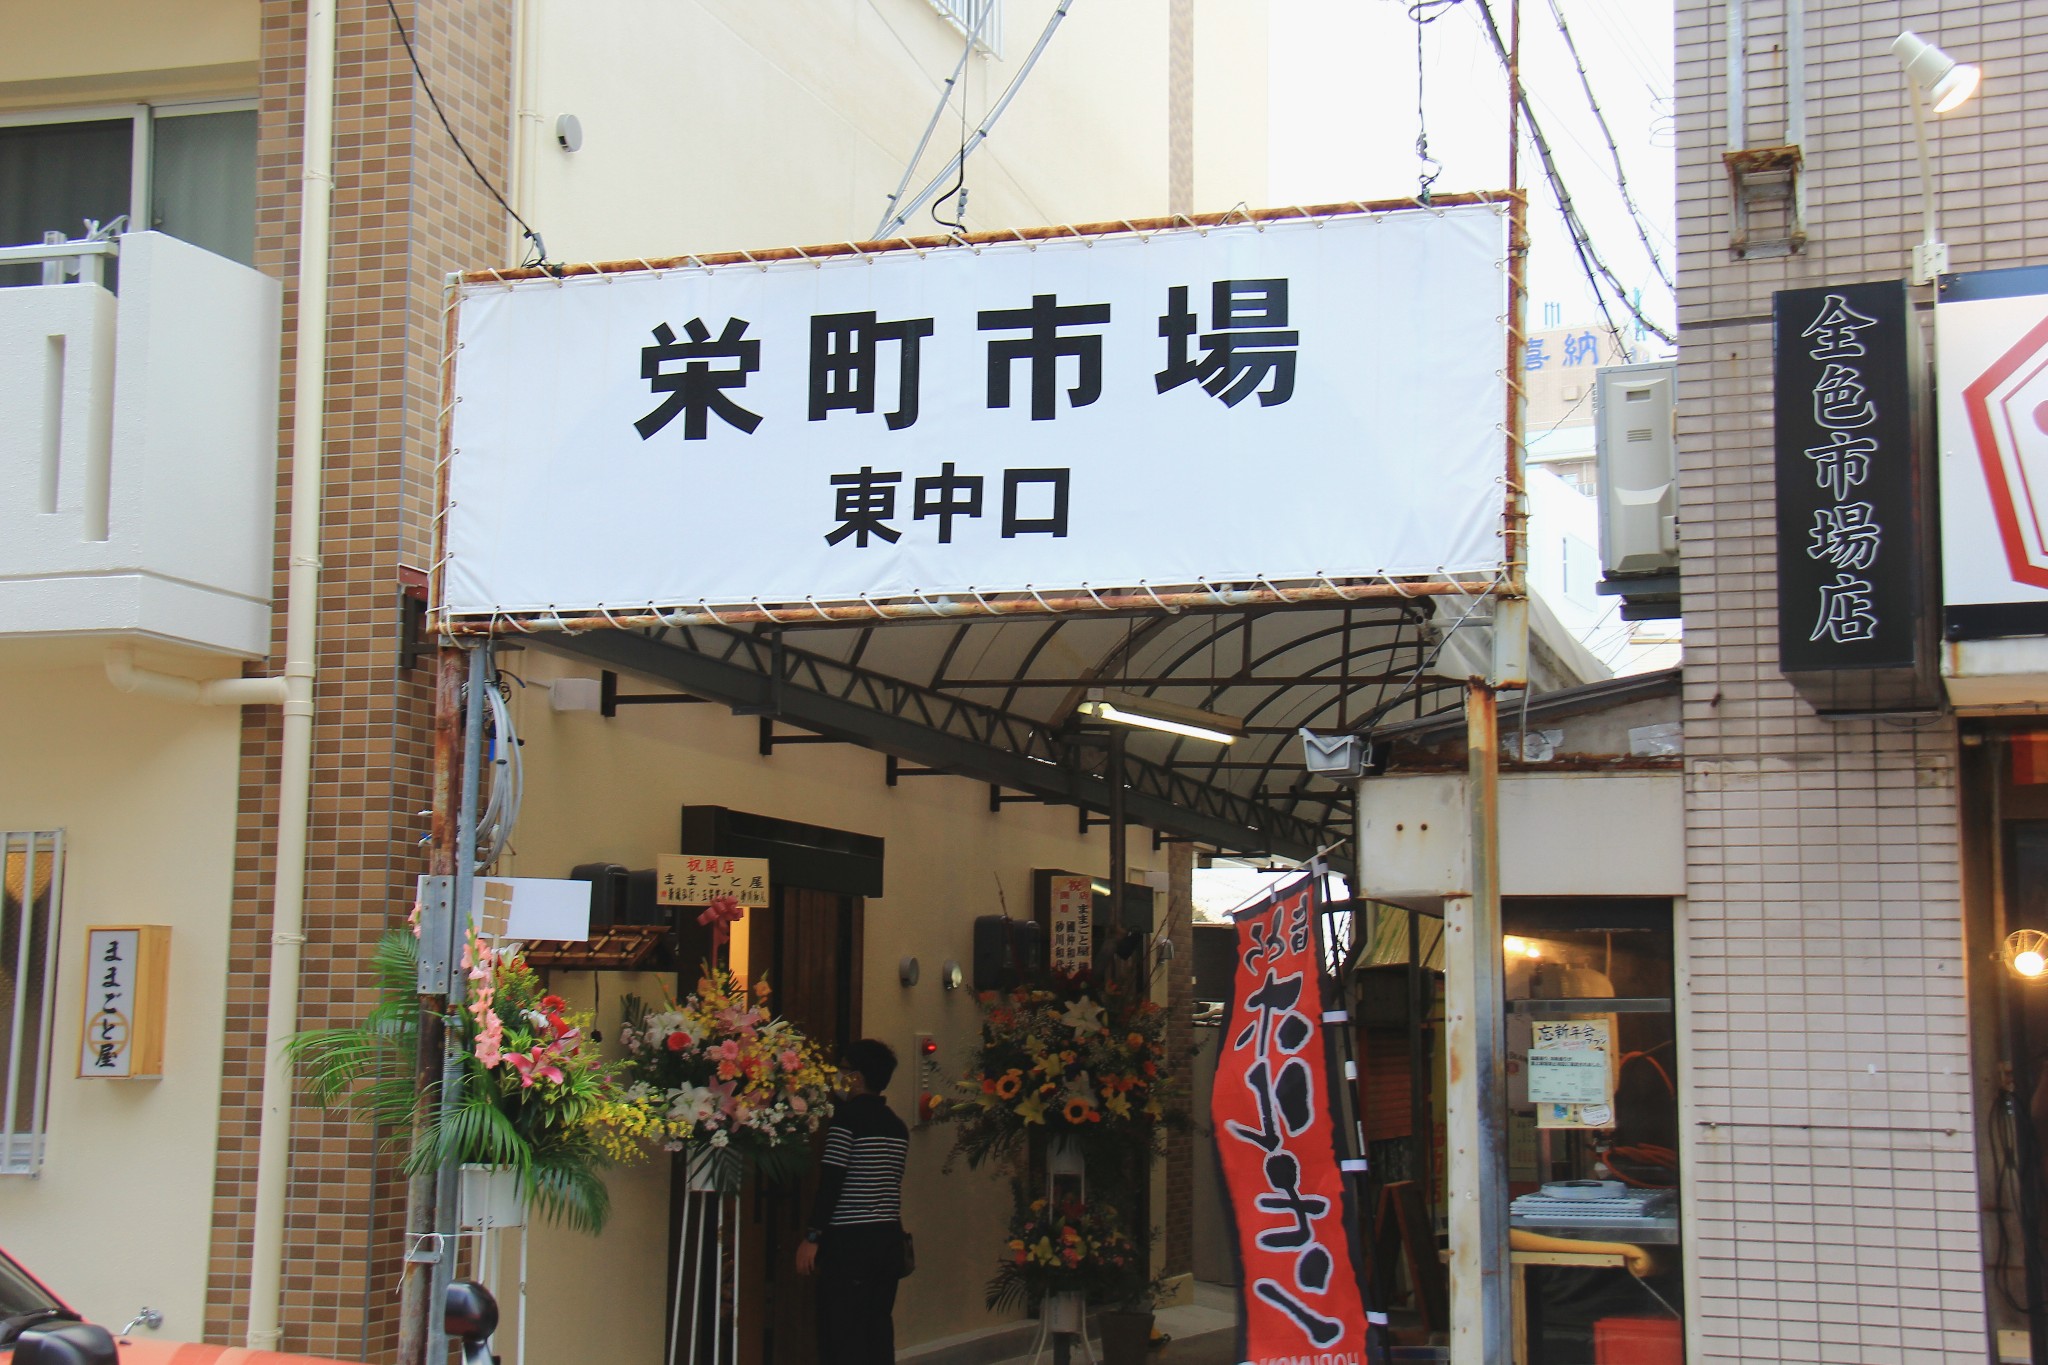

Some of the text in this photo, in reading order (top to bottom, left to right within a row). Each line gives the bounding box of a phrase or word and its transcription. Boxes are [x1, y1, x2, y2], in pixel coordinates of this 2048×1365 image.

[633, 278, 1300, 441] 栄町市場
[823, 462, 1071, 548] 東中口
[1801, 294, 1882, 644] 全色市場店
[664, 872, 765, 889] ままごと屋
[95, 940, 123, 1068] ままごと屋
